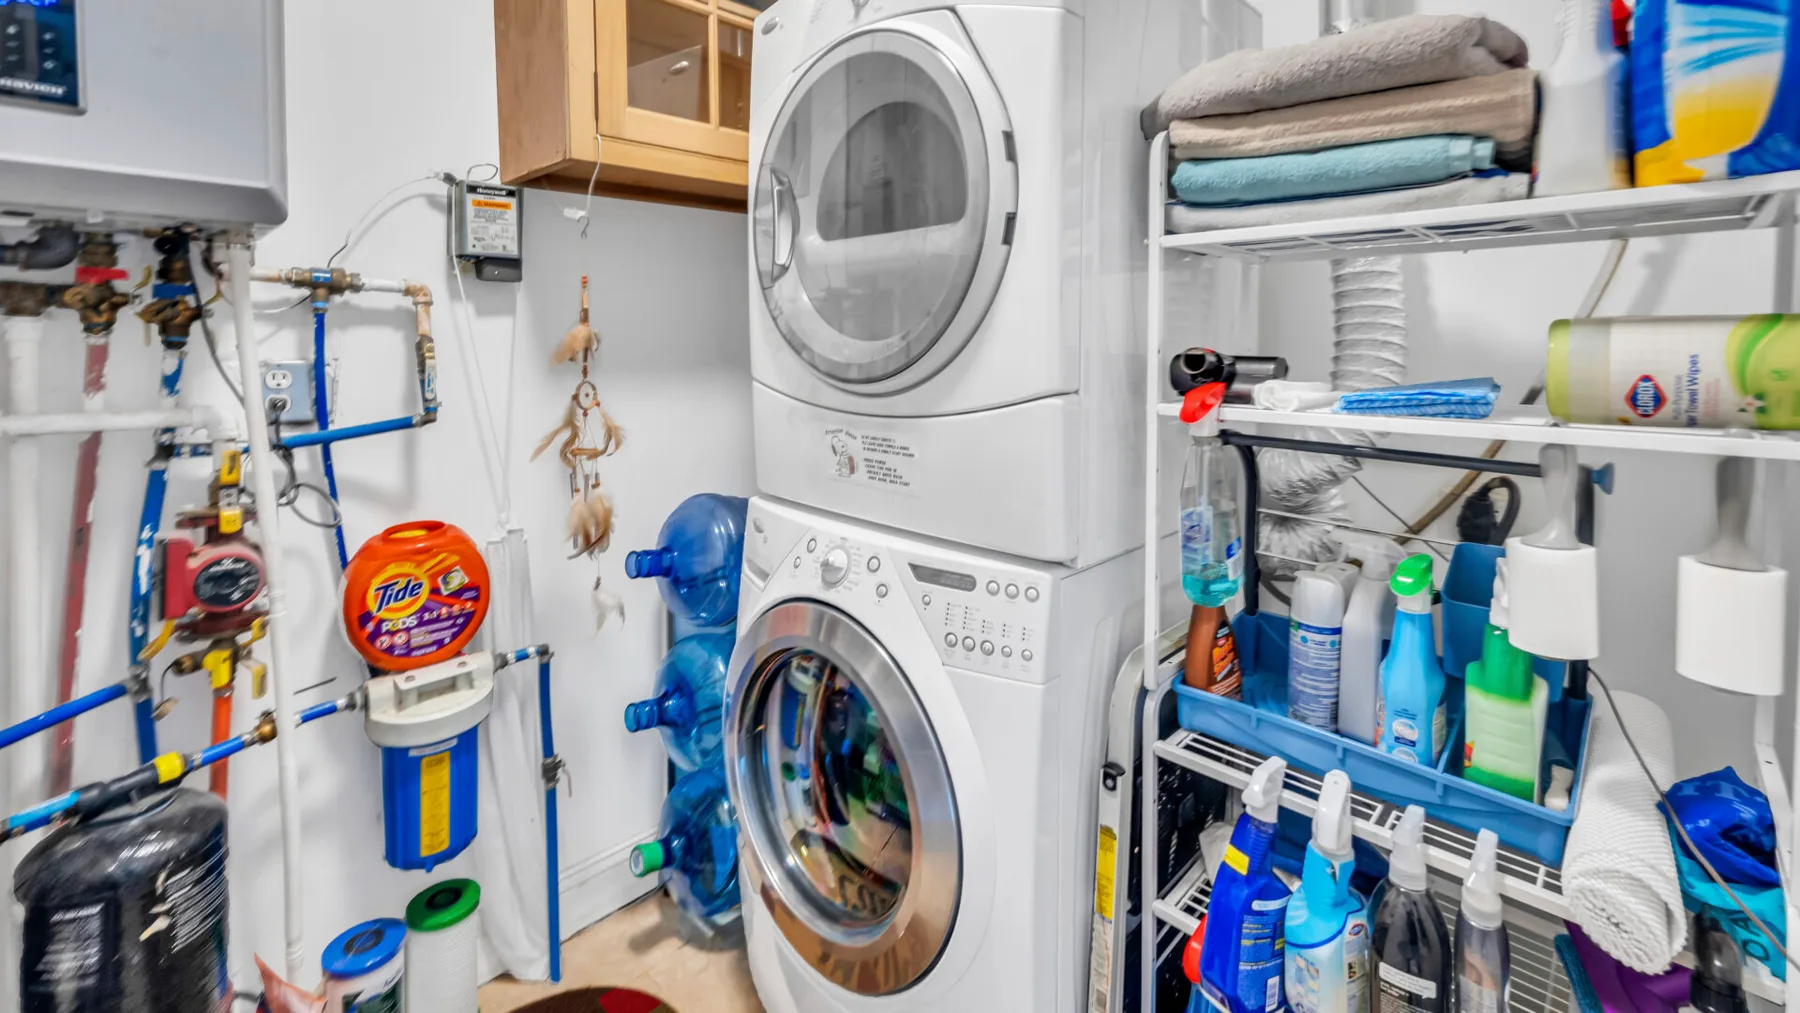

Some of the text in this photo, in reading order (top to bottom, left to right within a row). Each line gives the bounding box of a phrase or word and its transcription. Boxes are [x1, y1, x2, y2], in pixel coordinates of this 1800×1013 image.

[476, 187, 507, 196] Honeywell
[1686, 353, 1701, 387] Wipes
[1636, 380, 1656, 415] CLOROX
[1685, 388, 1699, 414] Towel
[373, 576, 424, 616] Tide
[381, 614, 418, 633] PODS
